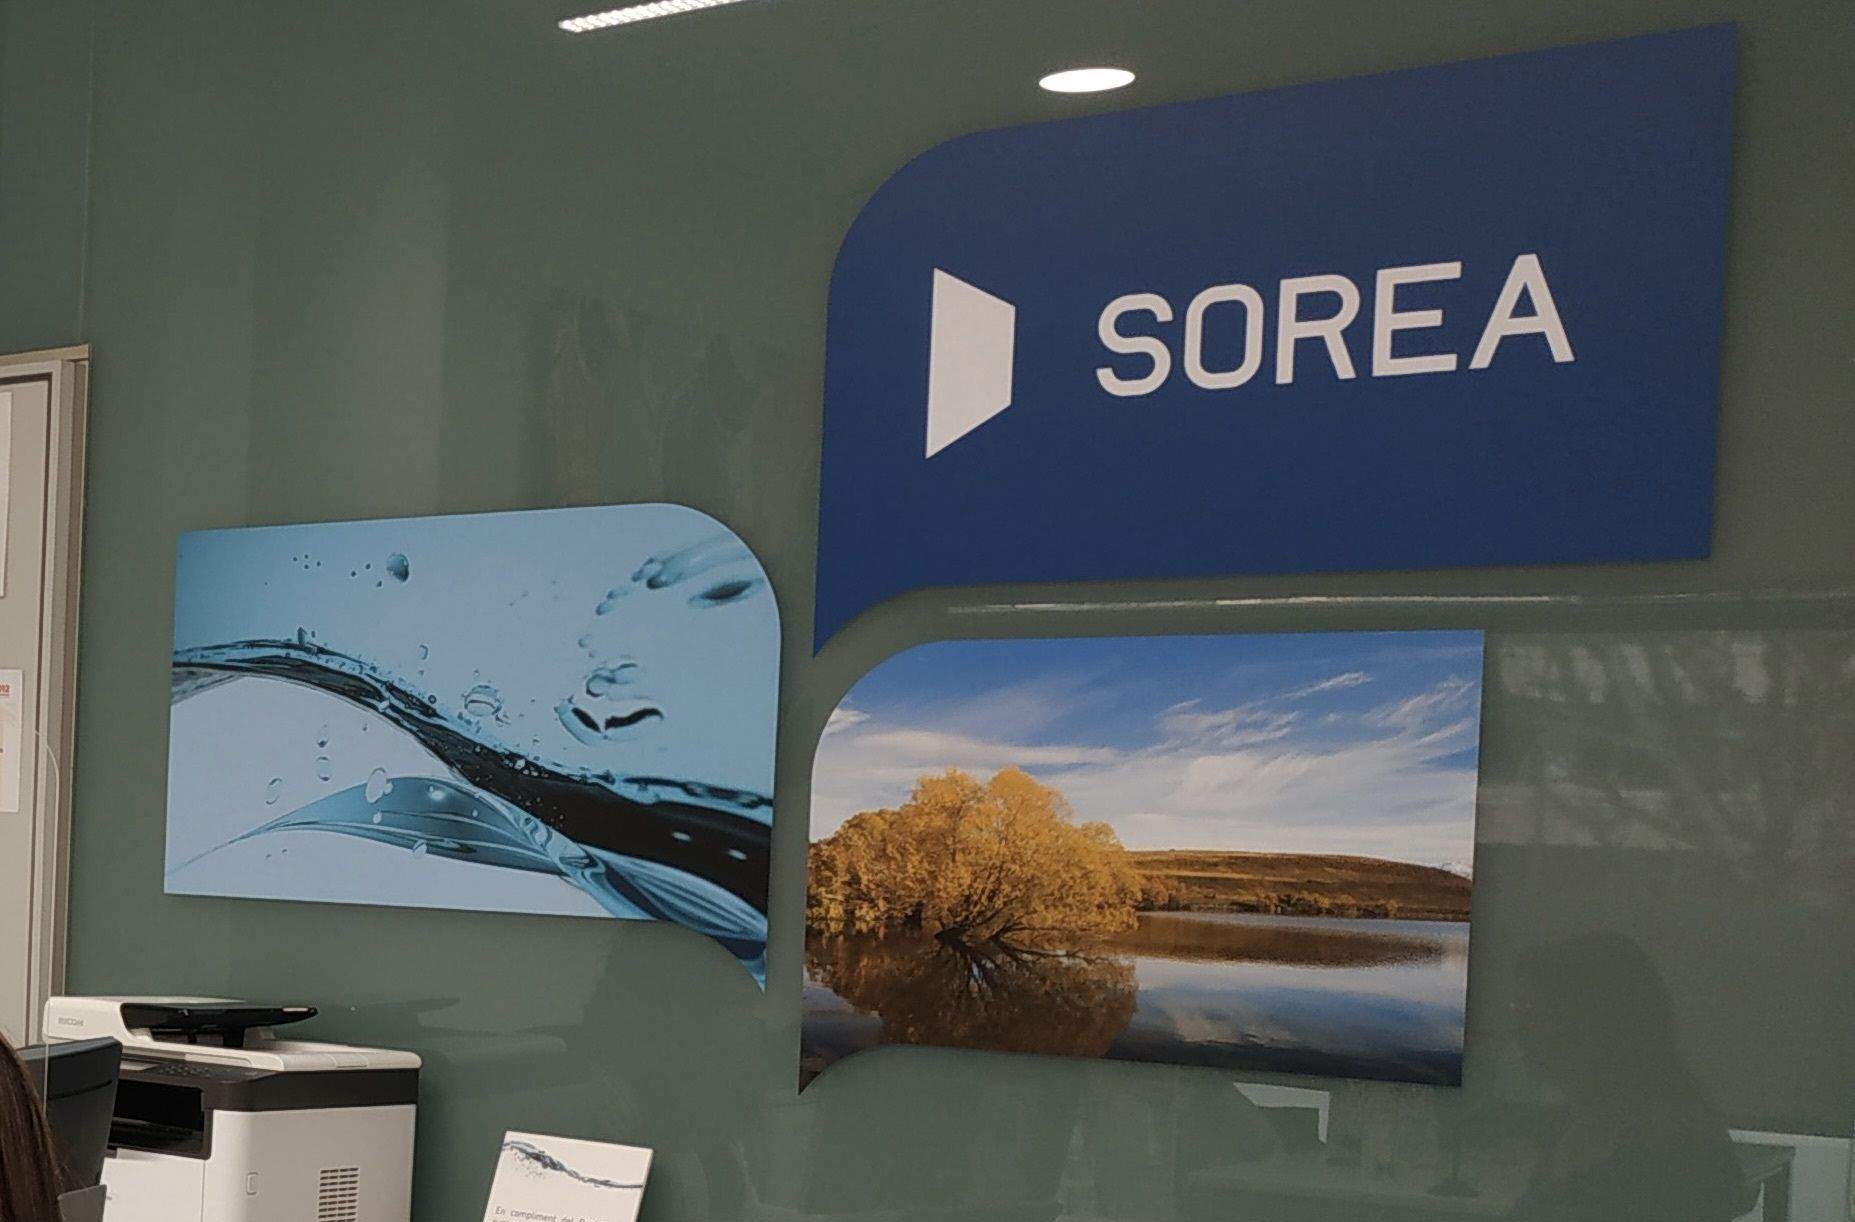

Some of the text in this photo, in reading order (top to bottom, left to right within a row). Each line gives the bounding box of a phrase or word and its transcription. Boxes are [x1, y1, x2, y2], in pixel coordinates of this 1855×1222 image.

[1096, 253, 1575, 397] SOREA
[496, 1206, 505, 1215] En
[510, 1210, 557, 1222] compliment
